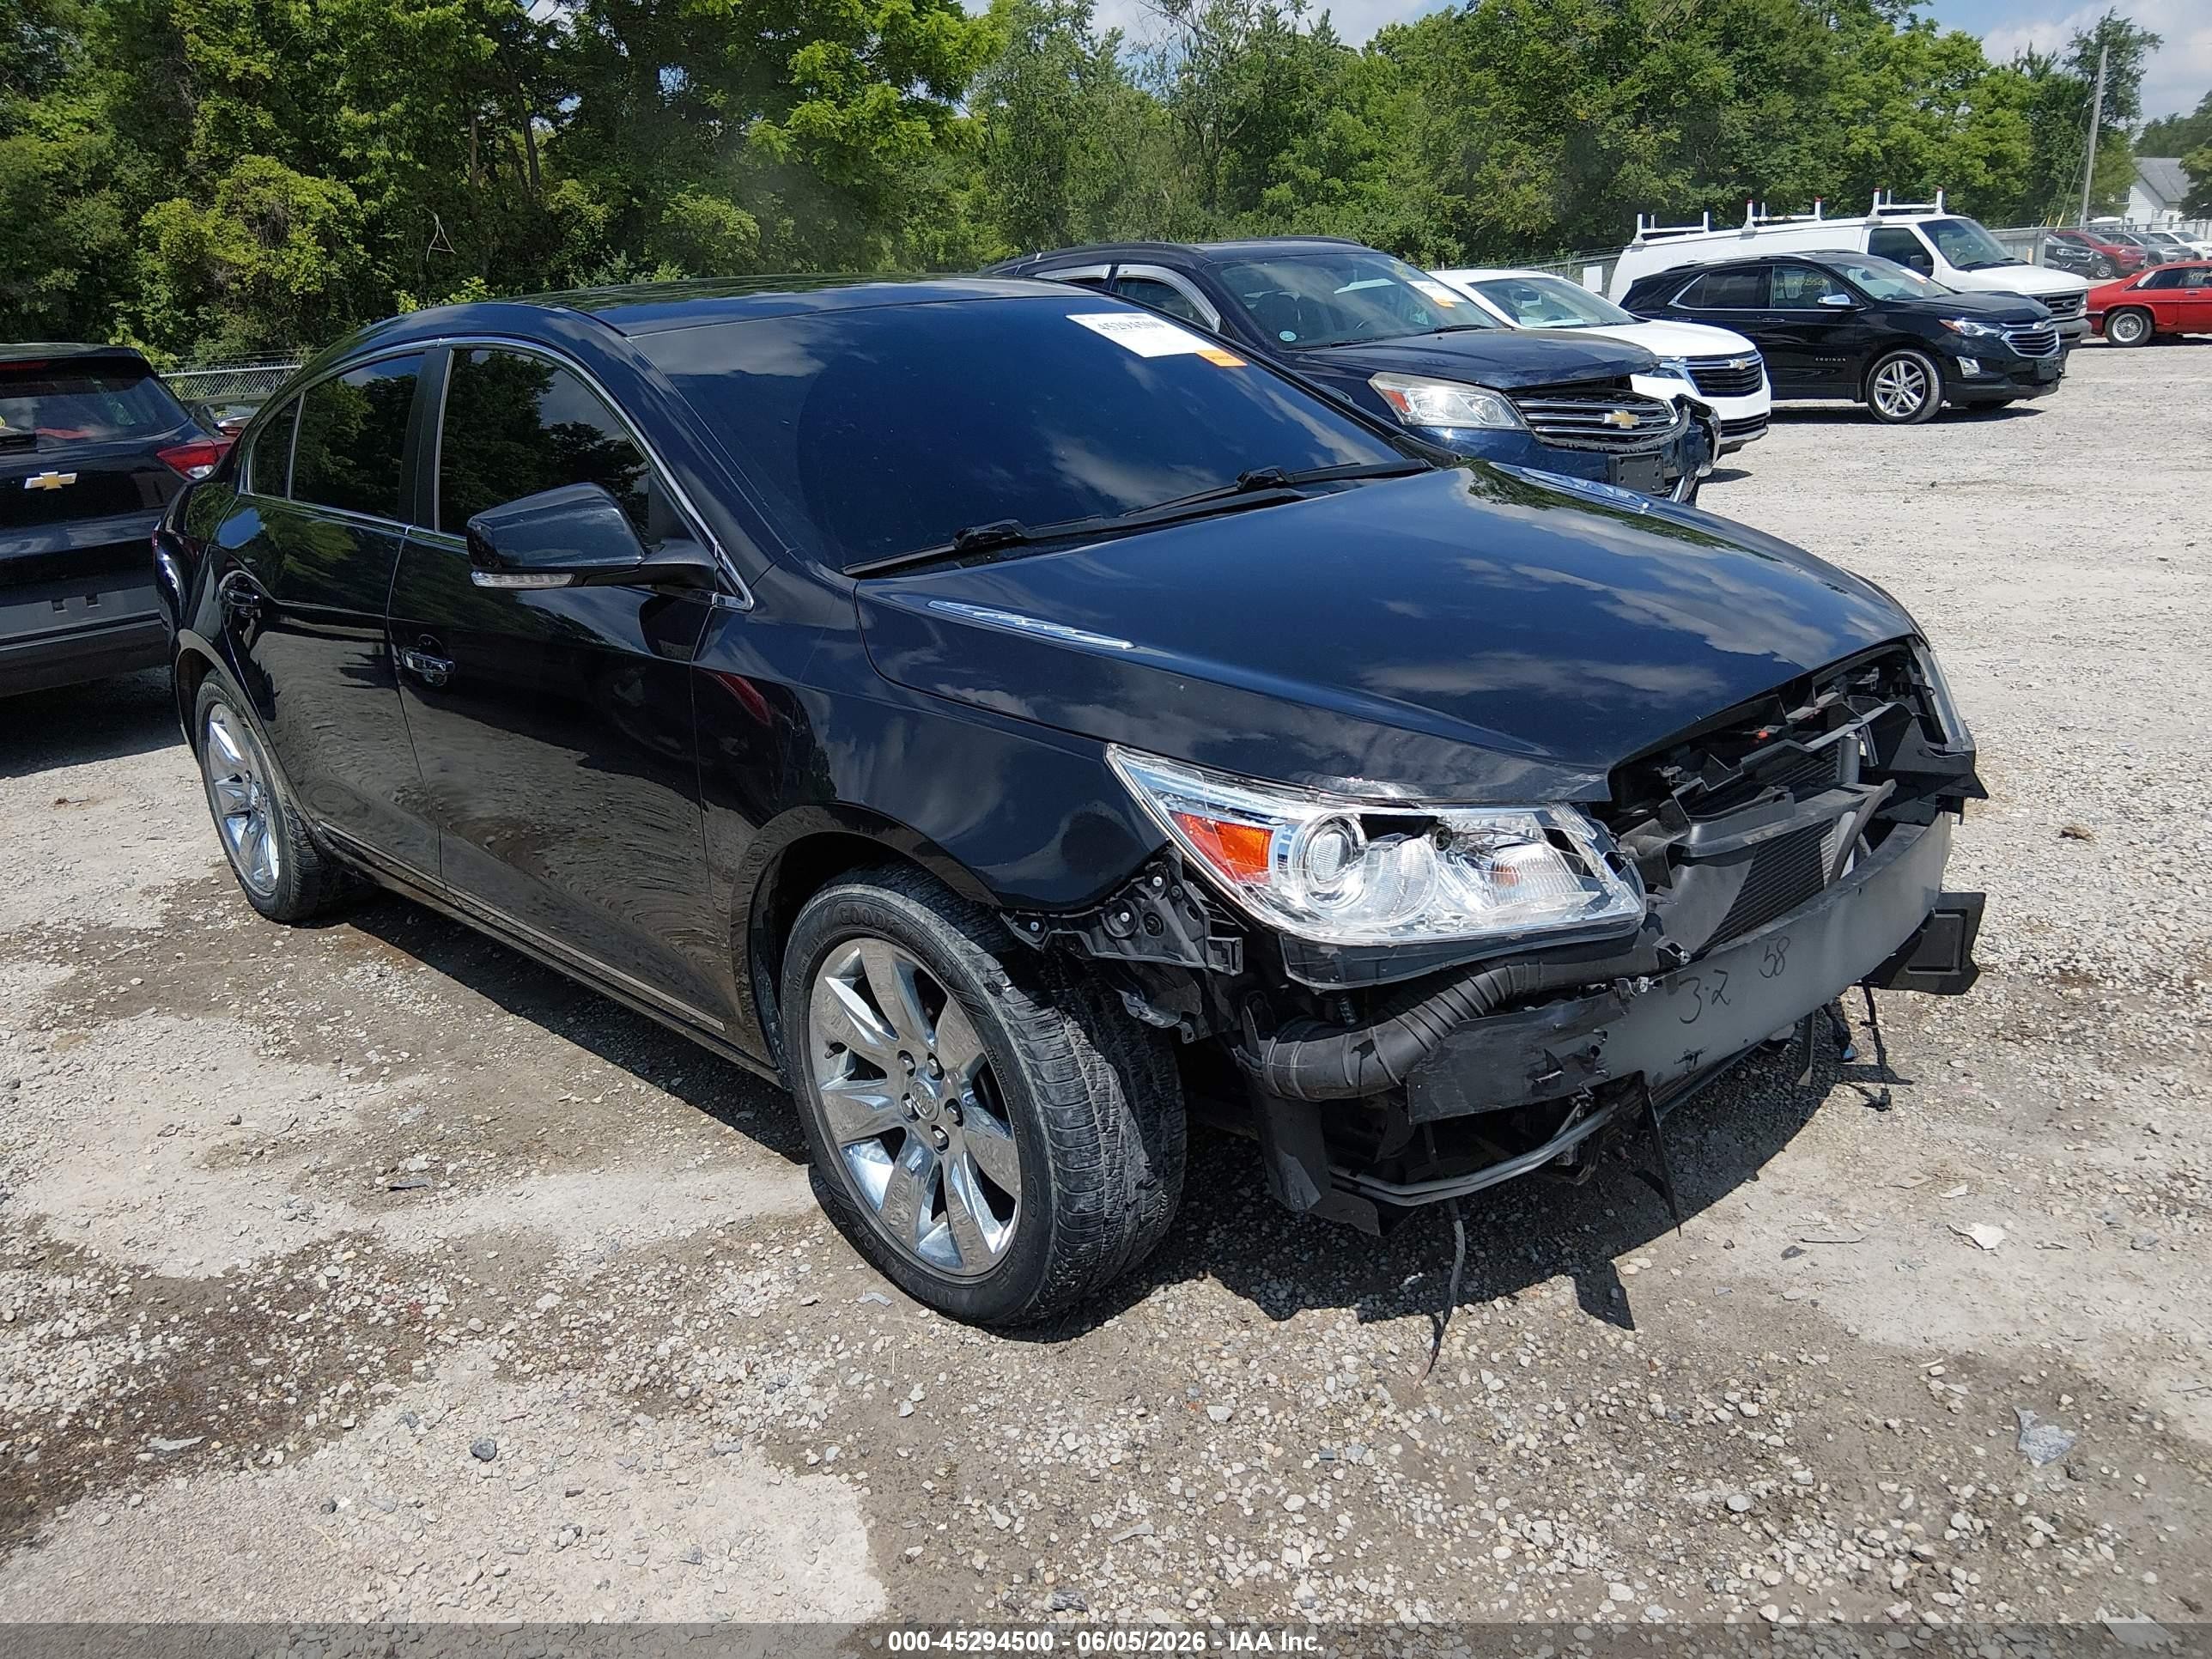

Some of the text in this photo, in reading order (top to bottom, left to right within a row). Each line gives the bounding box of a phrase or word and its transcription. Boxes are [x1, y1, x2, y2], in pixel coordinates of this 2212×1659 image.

[839, 904, 952, 978] GOODYEAR
[1759, 936, 1790, 978] 58
[853, 1222, 955, 1307] AURANCE
